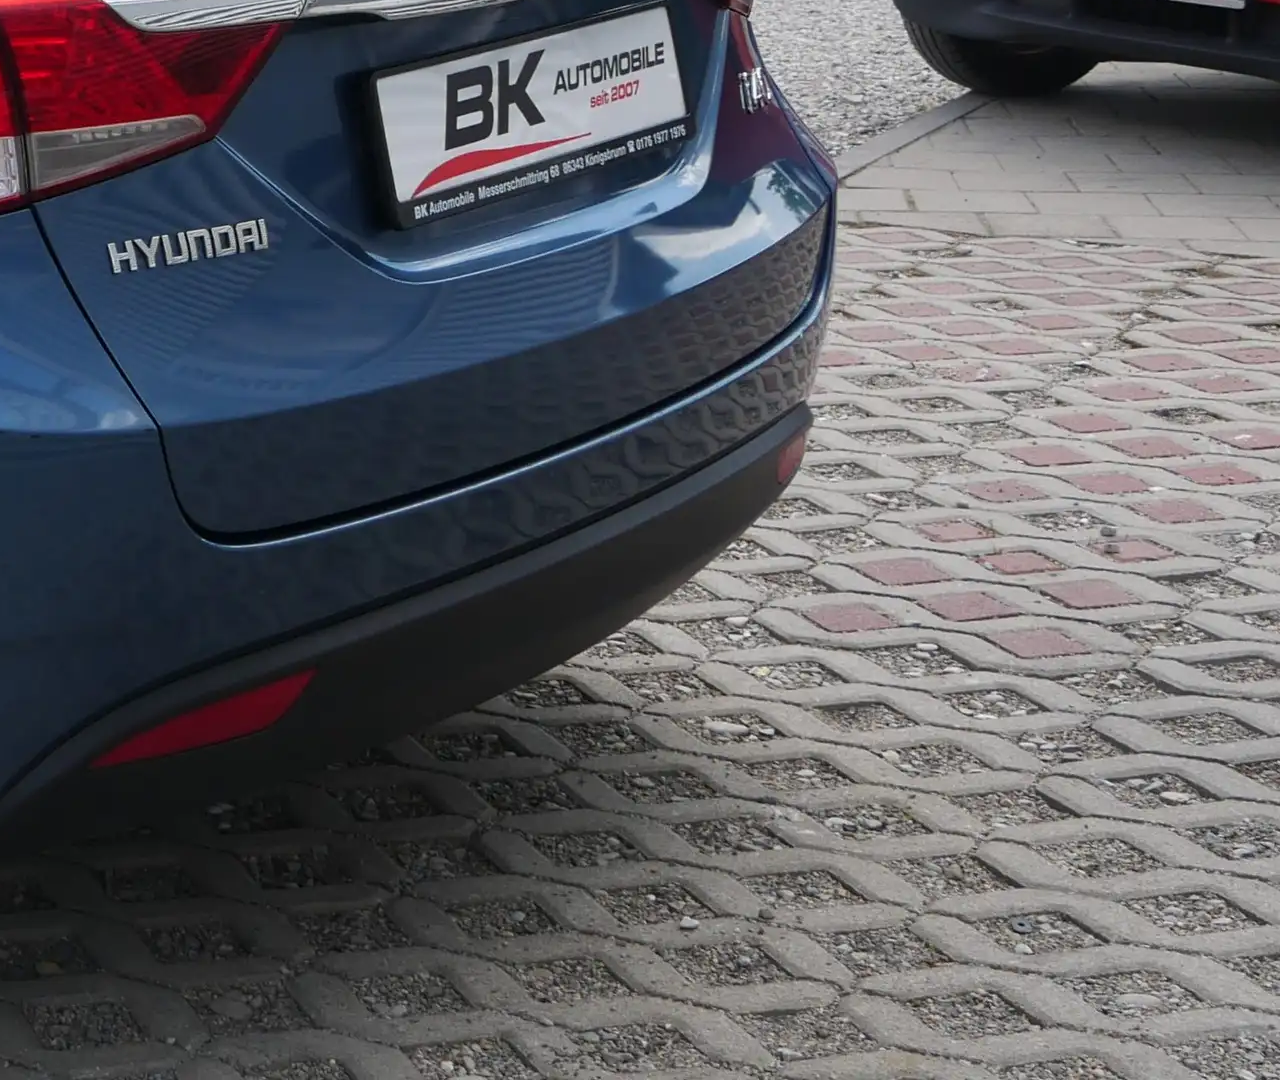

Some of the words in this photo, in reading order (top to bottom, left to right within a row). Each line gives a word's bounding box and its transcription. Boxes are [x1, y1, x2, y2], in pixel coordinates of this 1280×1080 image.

[445, 49, 546, 151] BK
[553, 42, 665, 95] AUTOMOBILE
[590, 88, 610, 108] seit
[610, 79, 640, 102] 2007
[413, 204, 430, 220] BK
[429, 190, 475, 215] Automobile
[478, 169, 550, 200] Messerschmittring
[562, 157, 585, 174] 86343
[585, 146, 627, 166] Königsbrunn
[635, 136, 653, 151] 0176
[653, 129, 669, 145] 1977
[669, 124, 686, 140] 1976
[106, 218, 269, 274] HYUNDAI
